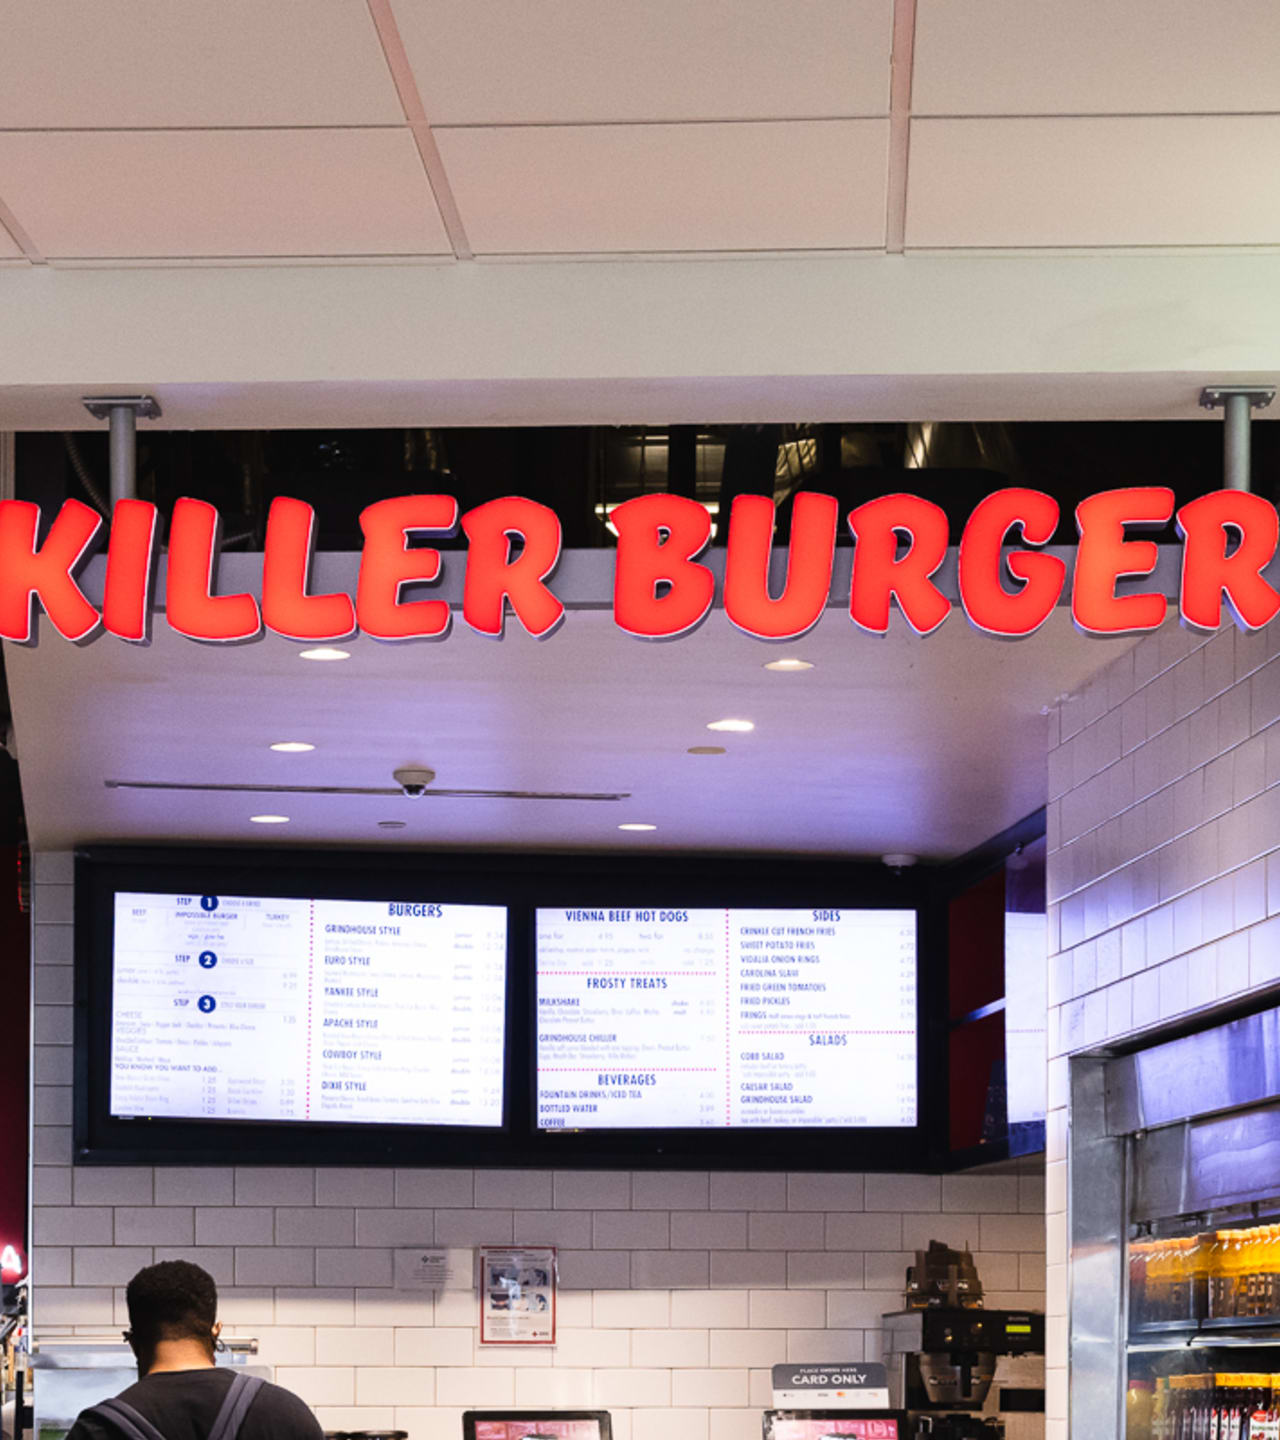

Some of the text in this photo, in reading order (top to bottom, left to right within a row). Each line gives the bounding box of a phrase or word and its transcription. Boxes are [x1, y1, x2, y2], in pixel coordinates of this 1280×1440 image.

[388, 903, 443, 918] BURGERS
[565, 910, 689, 922] VIENNA BEEF HOT DOGS
[812, 909, 841, 922] SIDES
[324, 923, 401, 936] GRINDHOUSE STYLE
[771, 927, 785, 936] CUT
[786, 927, 815, 936] FRENCH
[816, 927, 836, 936] FRIES
[765, 941, 794, 950] POTATO
[324, 955, 371, 967] EURO STYLE
[797, 955, 820, 964] RINGS
[587, 977, 668, 989] FROSTY TREATS
[740, 983, 827, 992] FRIED GREEN TOMATOES
[324, 987, 379, 998] YANKEE STYLE
[538, 998, 580, 1006] MILKSHAKE
[740, 996, 790, 1005] FRIED PICKLES
[323, 1018, 378, 1029] APACHE STYLE
[538, 1033, 617, 1042] GRINDHOUSE CHILLER
[809, 1034, 847, 1046] SALADS
[322, 1049, 382, 1061] COWBOY STYLE
[761, 1052, 785, 1061] SALAD
[130, 1063, 153, 1071] KNOW
[155, 1064, 169, 1072] YOU
[171, 1064, 191, 1072] WANT
[597, 1073, 657, 1086] BEVERAGES
[321, 1081, 367, 1091] DIXIE STYLE
[770, 1083, 793, 1091] SALAD
[539, 1090, 577, 1099] FOUNTAIN
[629, 1090, 642, 1099] TEA
[740, 1095, 813, 1104] GRINDHOUSE SALAD
[539, 1104, 598, 1113] BOTTLED WATER
[539, 1118, 565, 1127] COFFEE
[791, 1374, 867, 1385] CARD ONLY
